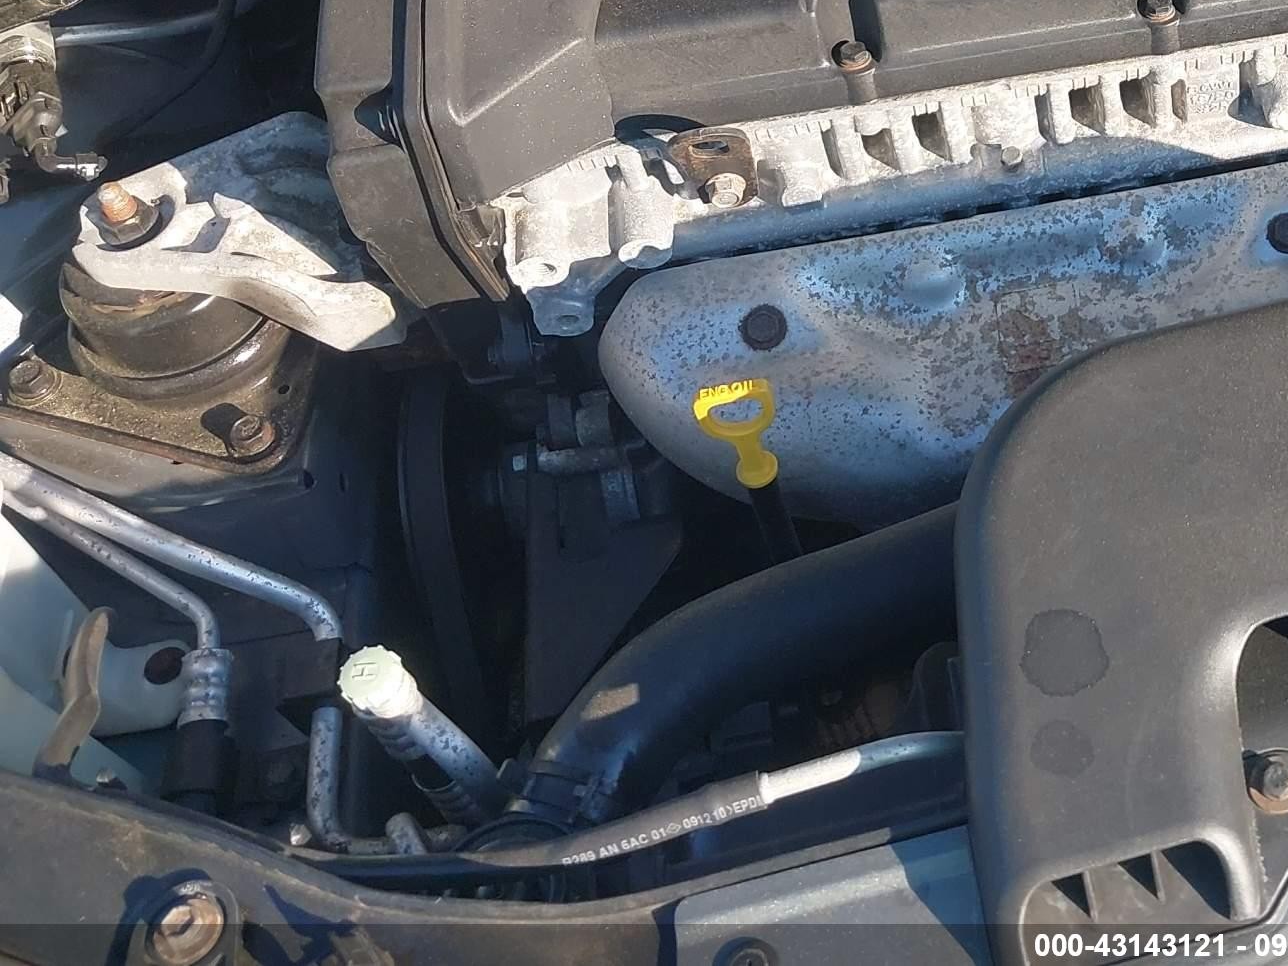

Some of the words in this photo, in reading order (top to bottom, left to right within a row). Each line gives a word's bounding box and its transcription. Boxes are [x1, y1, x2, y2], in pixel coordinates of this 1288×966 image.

[599, 843, 620, 859] AN
[621, 833, 649, 851] 6AC
[650, 827, 666, 841] 01
